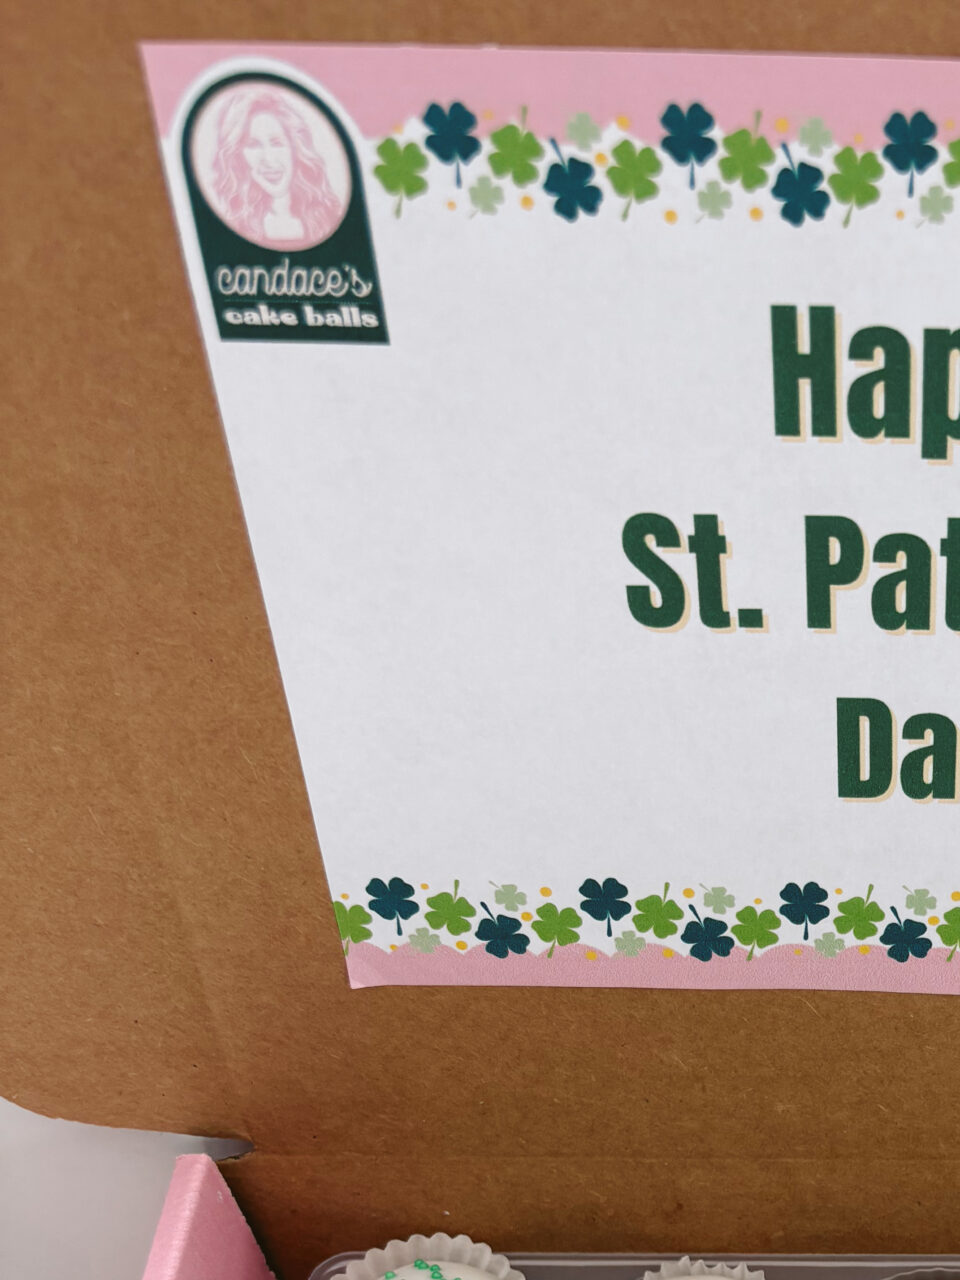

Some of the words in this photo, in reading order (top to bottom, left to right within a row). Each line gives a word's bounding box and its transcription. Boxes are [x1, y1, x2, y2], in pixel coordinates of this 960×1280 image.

[217, 257, 372, 298] candace's
[224, 303, 298, 326] cake
[303, 304, 379, 327] balls
[621, 512, 769, 634] St.
